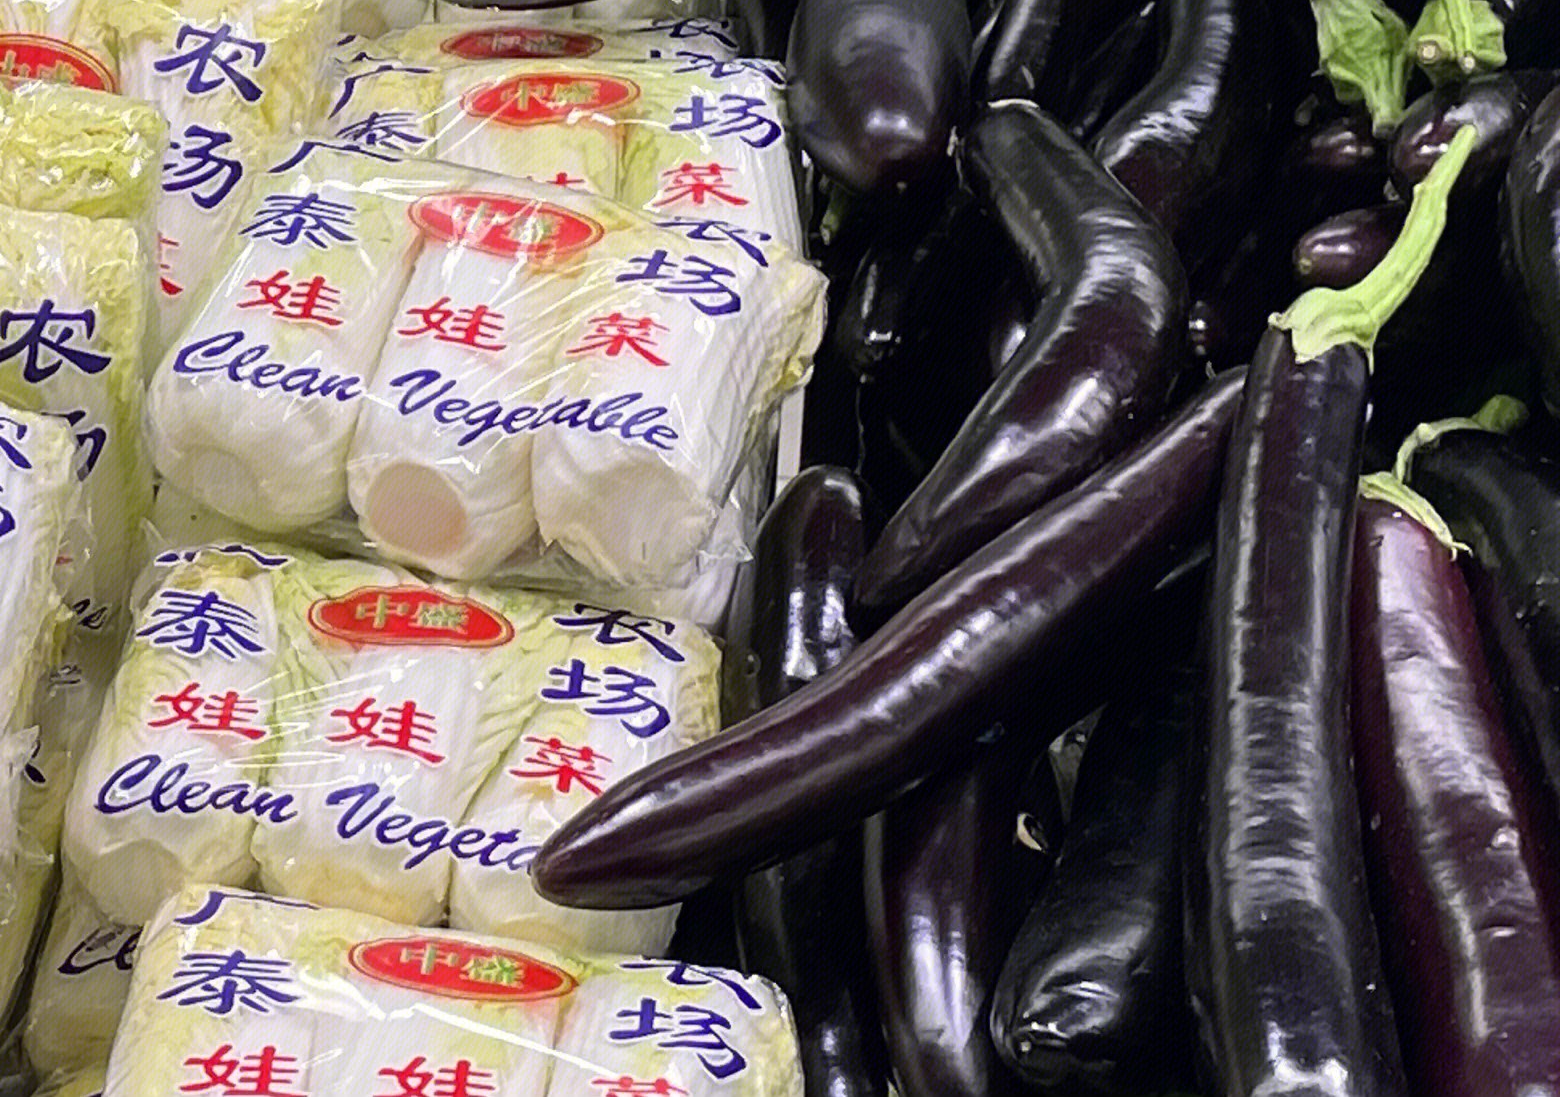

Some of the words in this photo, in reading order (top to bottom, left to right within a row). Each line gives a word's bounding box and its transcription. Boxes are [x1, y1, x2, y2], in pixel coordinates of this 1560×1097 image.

[173, 330, 363, 402] Clean
[390, 369, 680, 452] Vegetable
[95, 753, 298, 824] Clean
[326, 781, 538, 872] Vegeta
